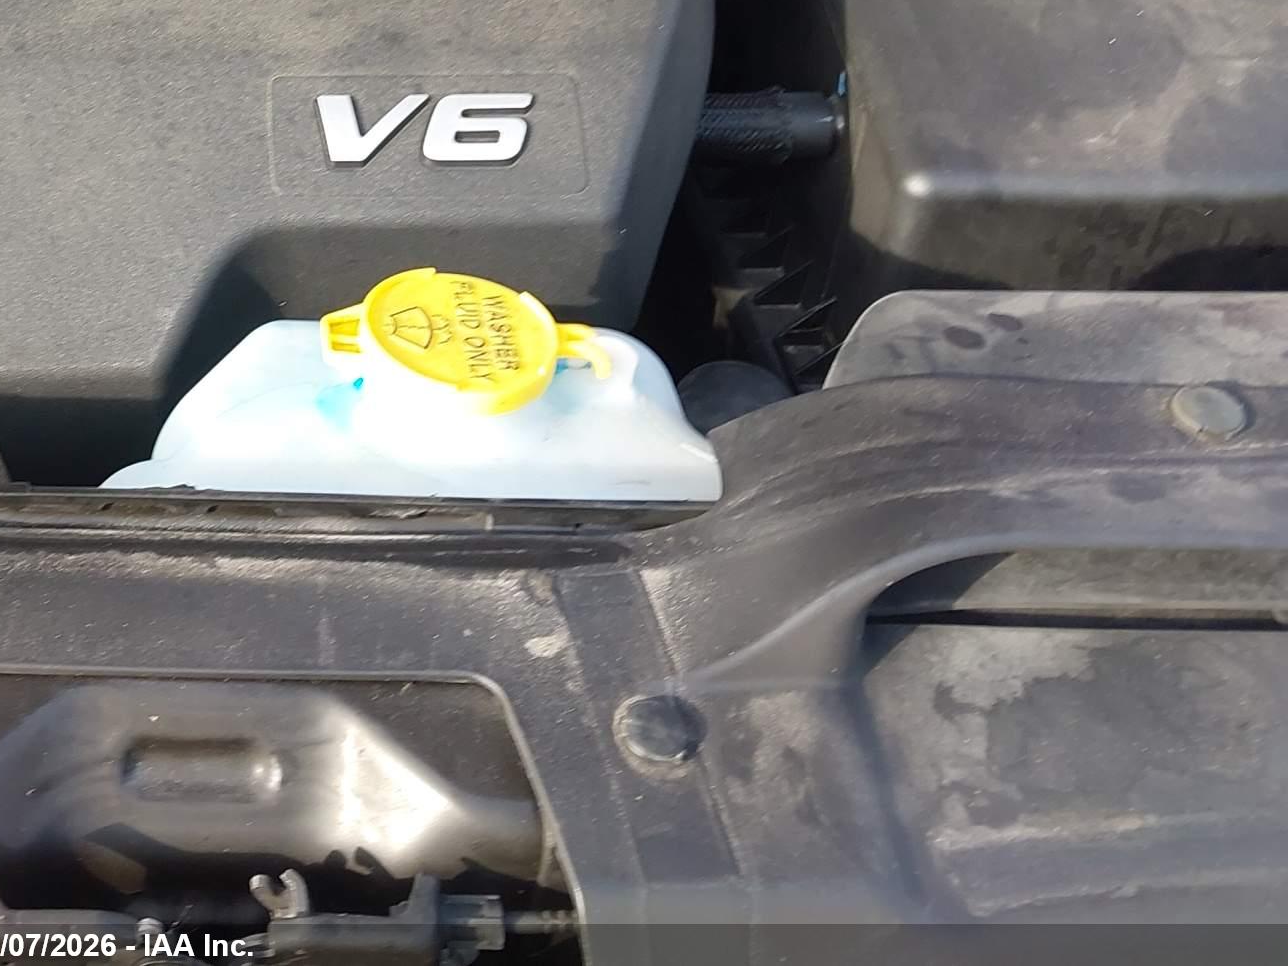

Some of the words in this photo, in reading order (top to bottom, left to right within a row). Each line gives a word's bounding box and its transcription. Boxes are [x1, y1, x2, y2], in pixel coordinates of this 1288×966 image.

[316, 93, 535, 168] V6
[450, 280, 481, 331] FLUID
[481, 294, 520, 371] WASHER
[464, 336, 497, 381] ONLY
